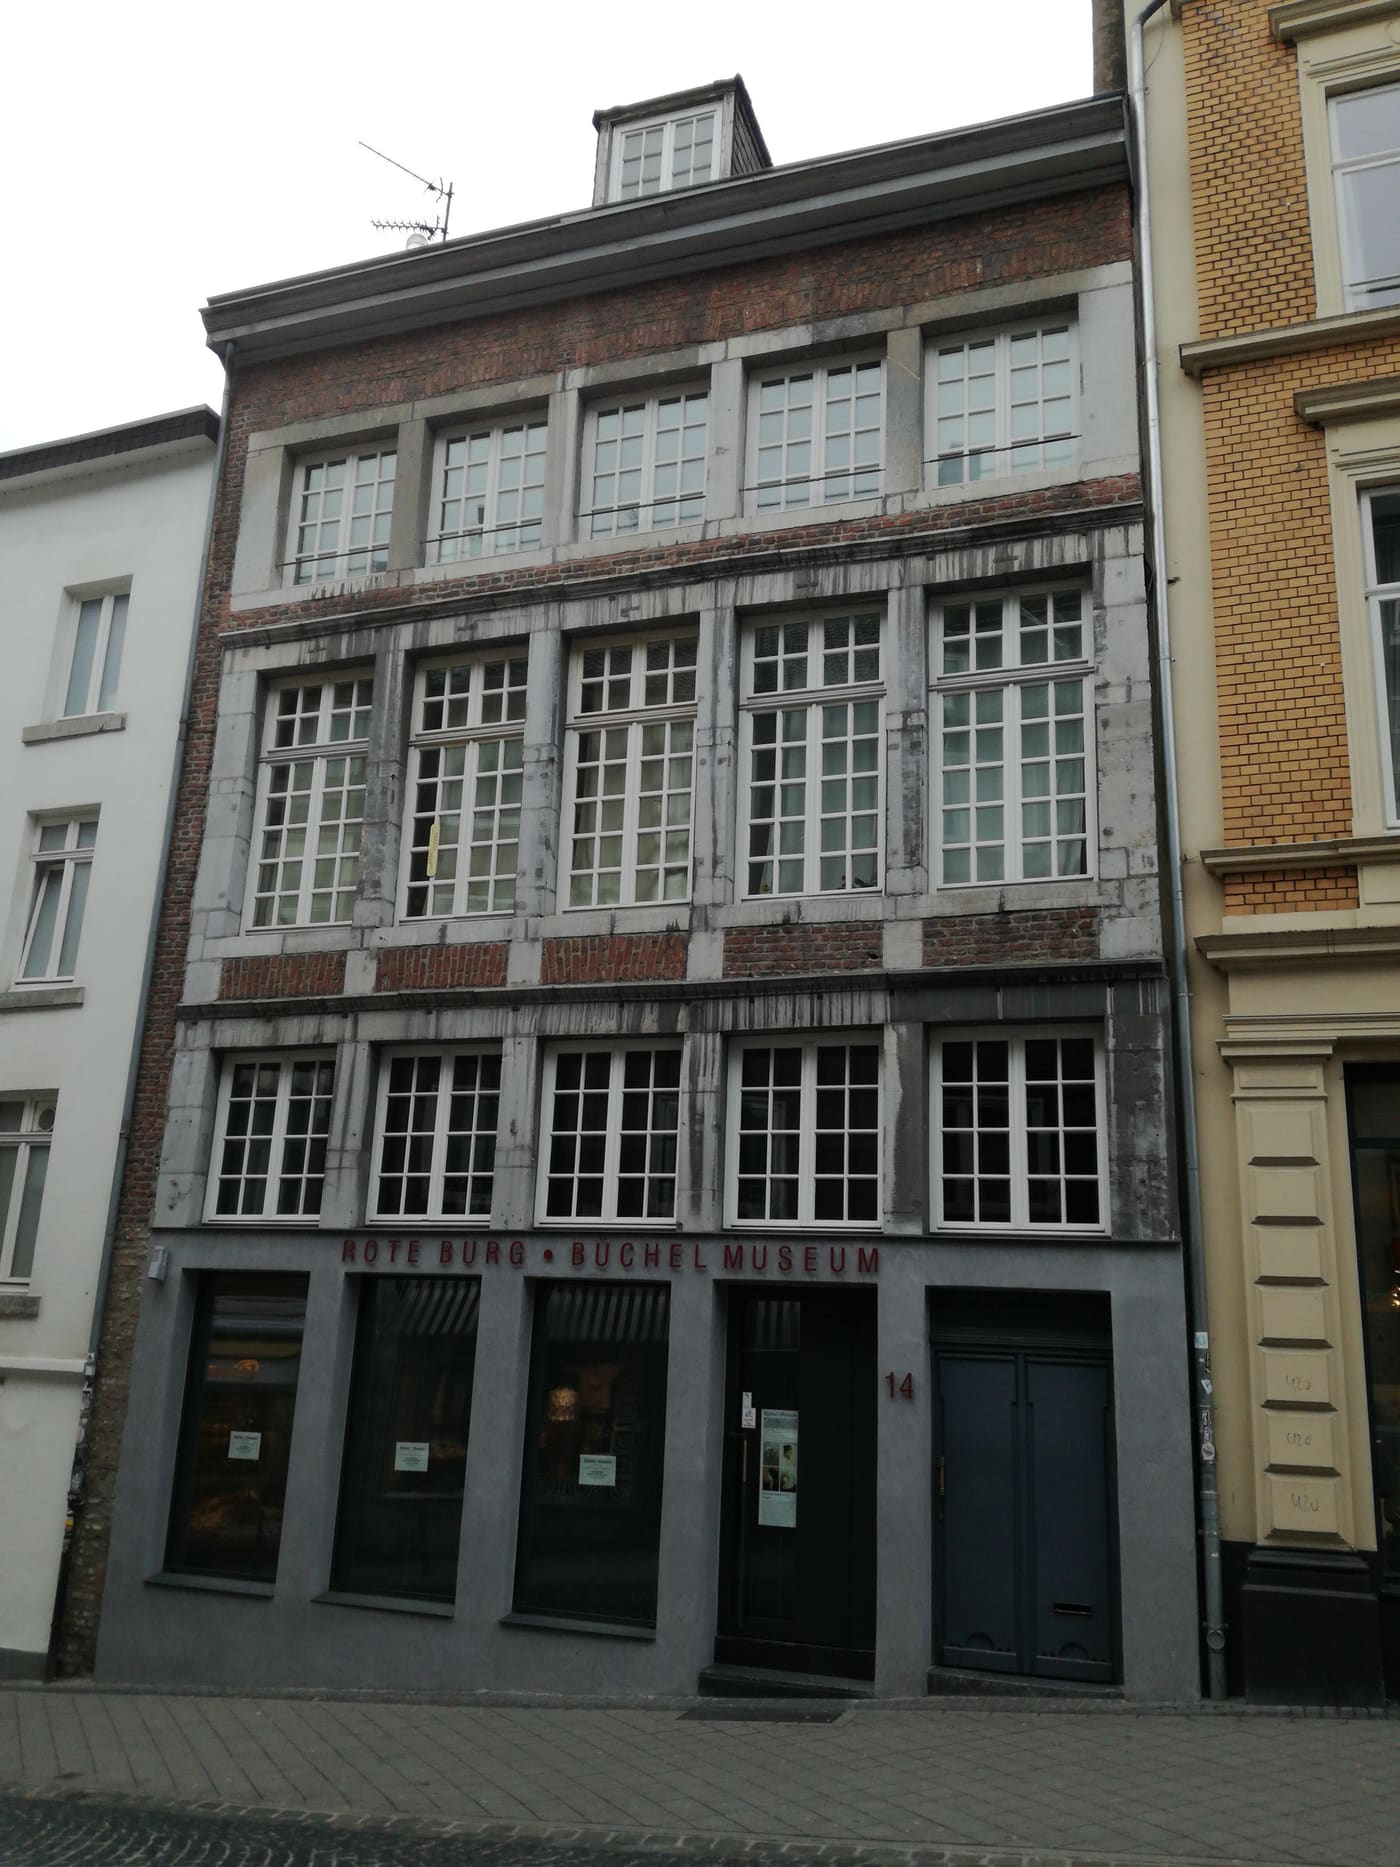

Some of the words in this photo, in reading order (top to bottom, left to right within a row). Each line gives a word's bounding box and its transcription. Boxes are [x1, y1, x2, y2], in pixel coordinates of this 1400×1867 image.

[341, 1240, 420, 1264] ROTE
[439, 1240, 525, 1265] BURG
[571, 1238, 707, 1269] BÜCHEL
[723, 1244, 879, 1272] MUSEUM
[885, 1371, 914, 1400] 14
